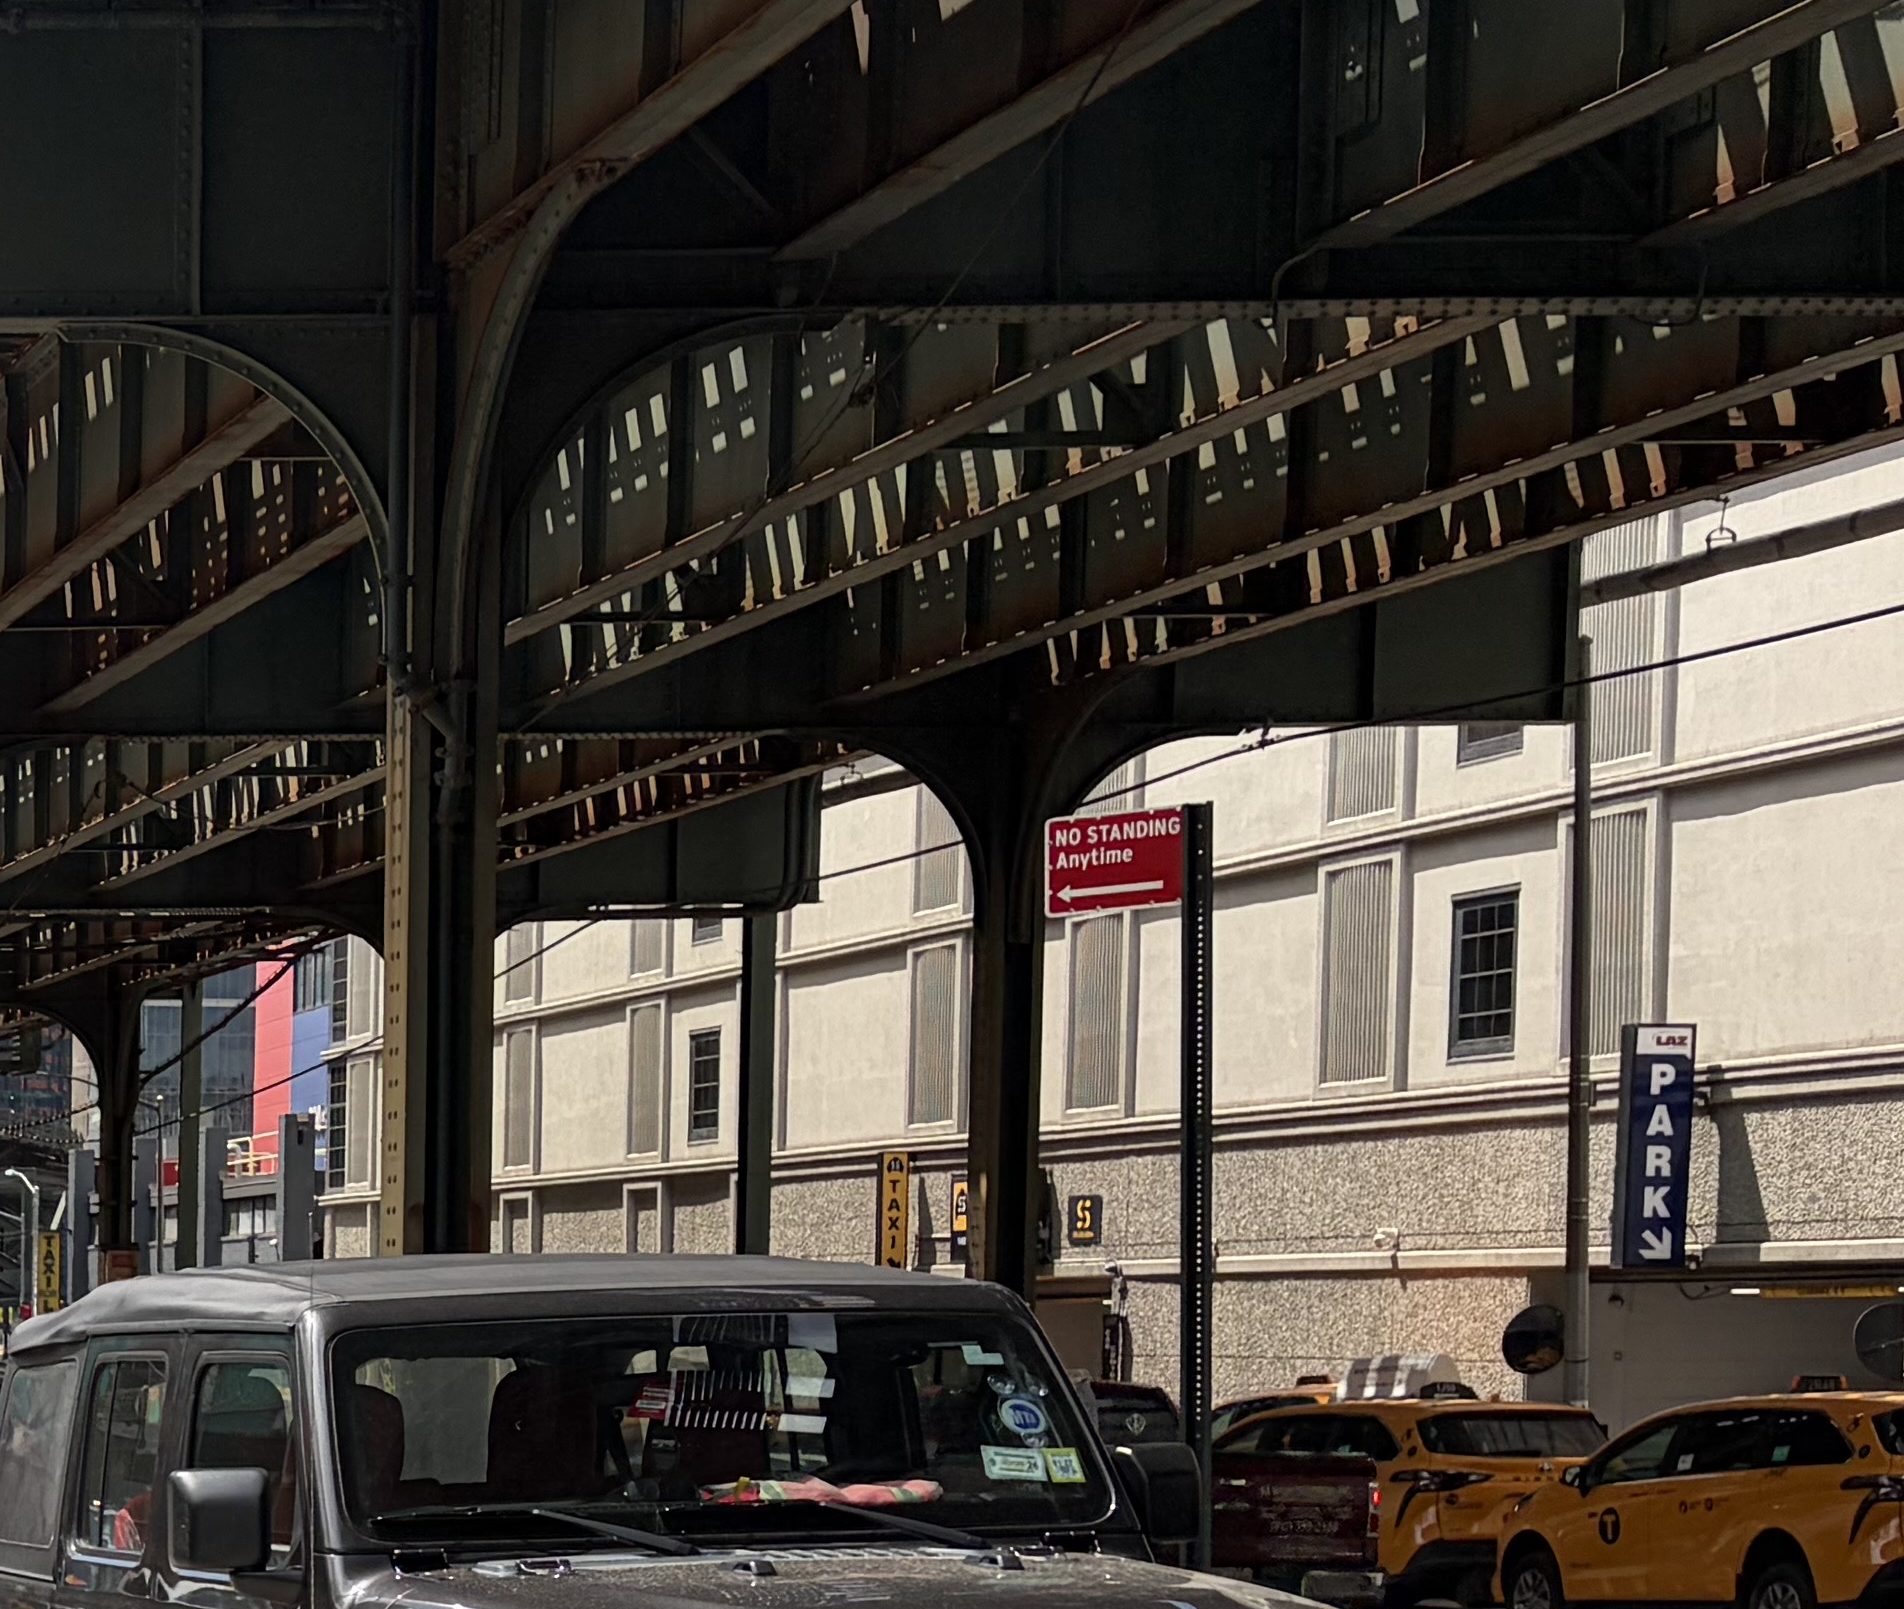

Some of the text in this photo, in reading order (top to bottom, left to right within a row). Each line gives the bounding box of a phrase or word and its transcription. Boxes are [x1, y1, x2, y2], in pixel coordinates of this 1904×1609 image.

[1055, 816, 1181, 847] NO STANDING
[1056, 846, 1133, 871] Anytime
[1655, 1035, 1688, 1047] LAZ
[1643, 1062, 1676, 1218] PARK
[888, 1179, 901, 1250] TAXI
[43, 1235, 55, 1288] TAXI
